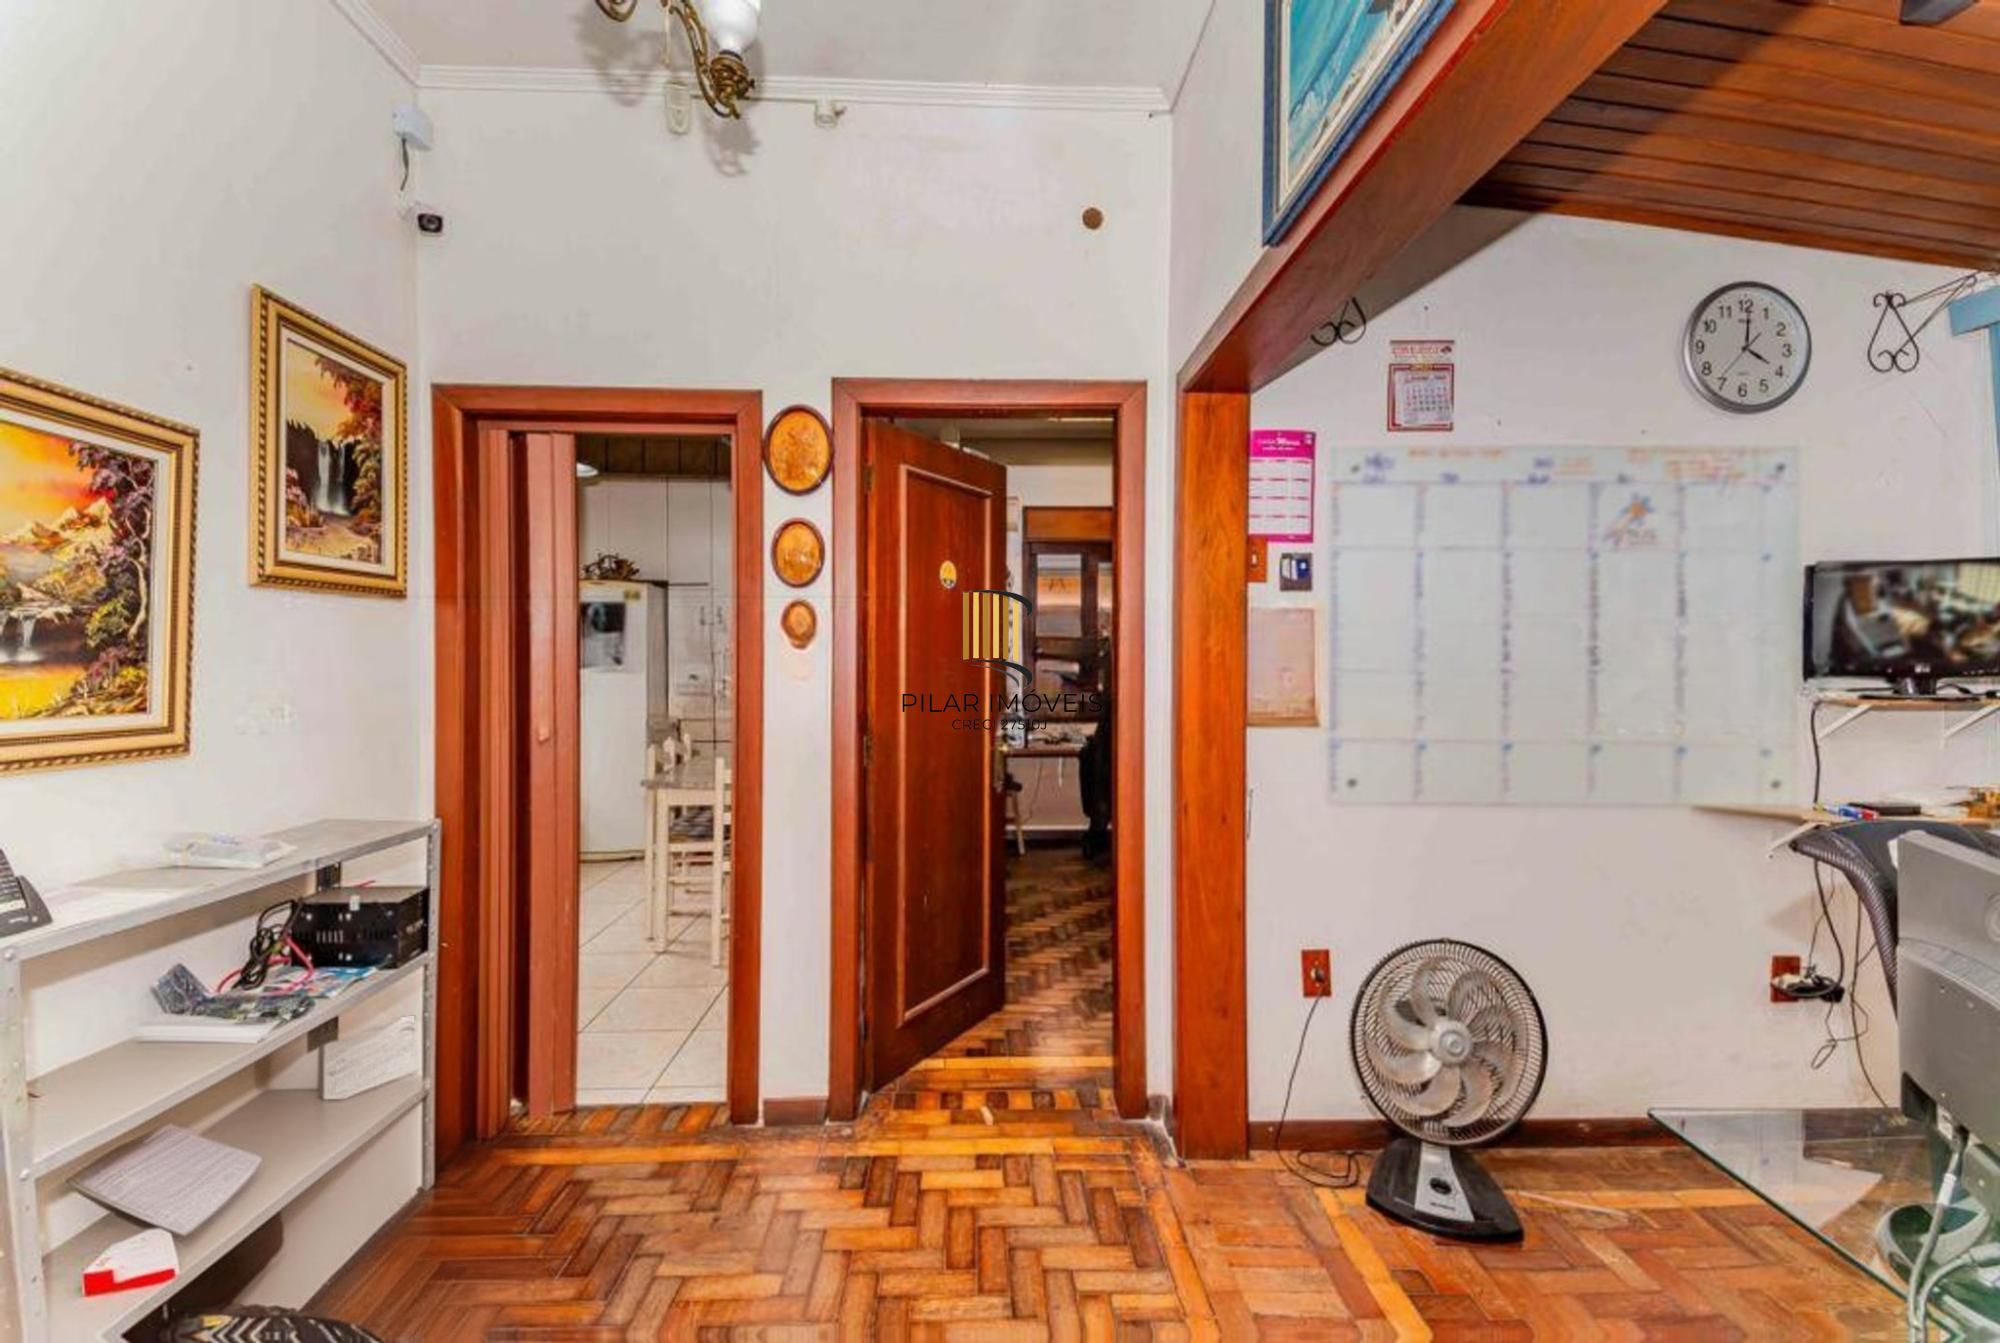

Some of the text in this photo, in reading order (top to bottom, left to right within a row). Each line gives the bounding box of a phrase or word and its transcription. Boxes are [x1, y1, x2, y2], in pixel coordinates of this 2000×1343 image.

[1718, 306, 1732, 318] 11
[1738, 299, 1754, 314] 12
[1763, 307, 1769, 319] 1
[1704, 319, 1717, 333] 10
[1776, 322, 1786, 337] 2
[1695, 340, 1705, 354] 9
[1782, 343, 1792, 358] 3
[1701, 361, 1712, 376] 8
[1775, 365, 1783, 378] 4
[1717, 377, 1727, 391] 7
[1738, 383, 1747, 397] 6
[1759, 379, 1769, 393] 5
